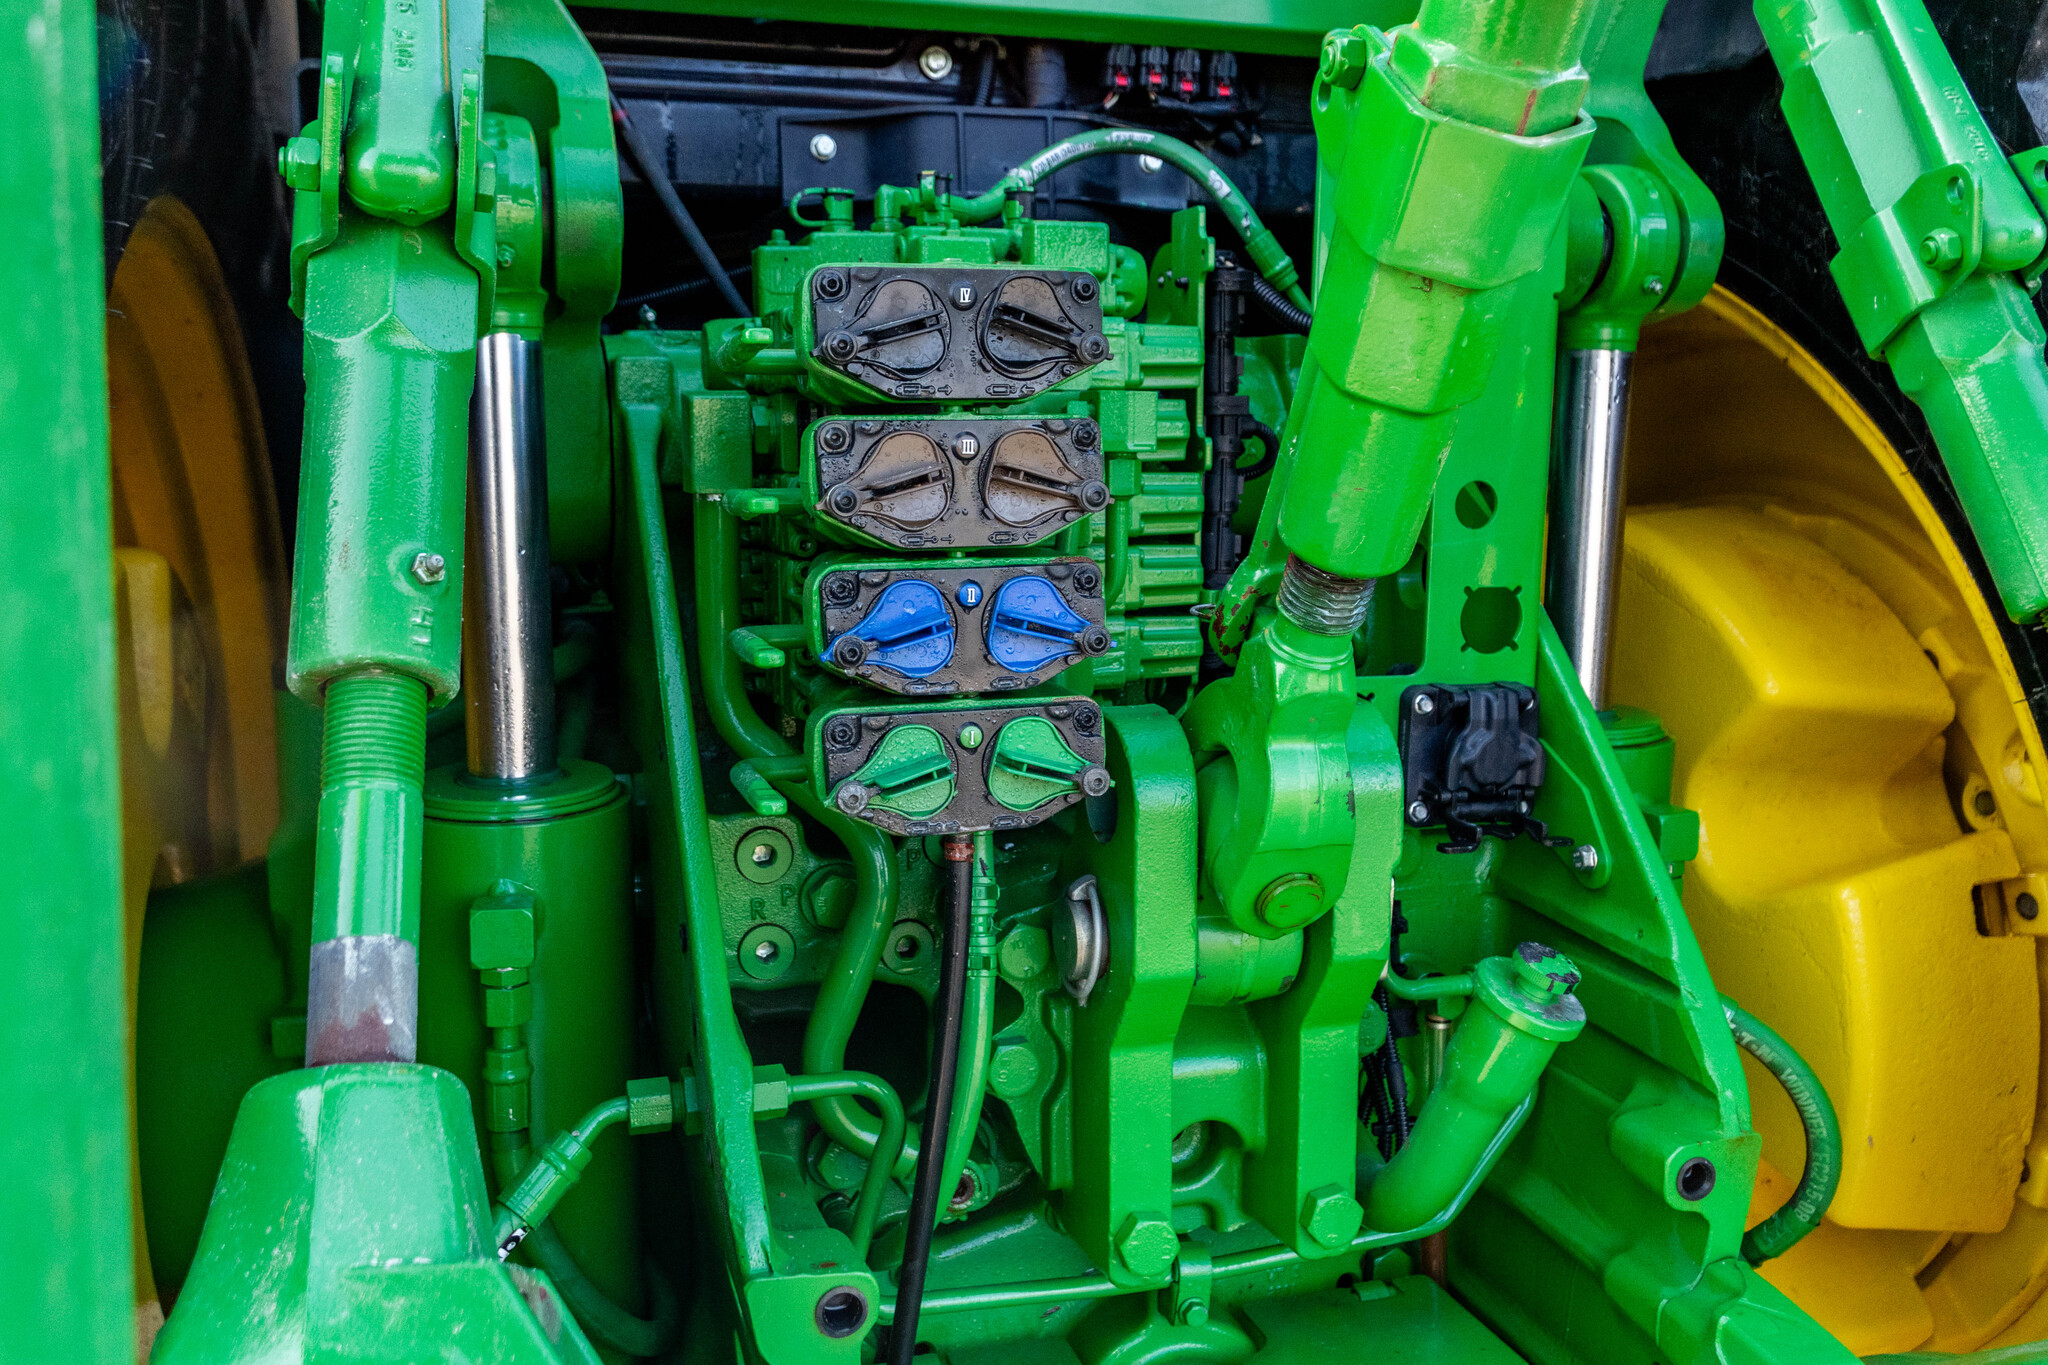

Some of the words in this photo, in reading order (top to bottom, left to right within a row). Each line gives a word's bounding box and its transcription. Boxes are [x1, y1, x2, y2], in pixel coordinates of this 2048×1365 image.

[959, 287, 972, 303] IV
[961, 439, 975, 455] III
[967, 587, 976, 603] II
[970, 730, 975, 745] I
[906, 848, 921, 871] P
[780, 883, 797, 907] P
[748, 896, 767, 921] R
[1780, 1066, 1828, 1139] WINNER
